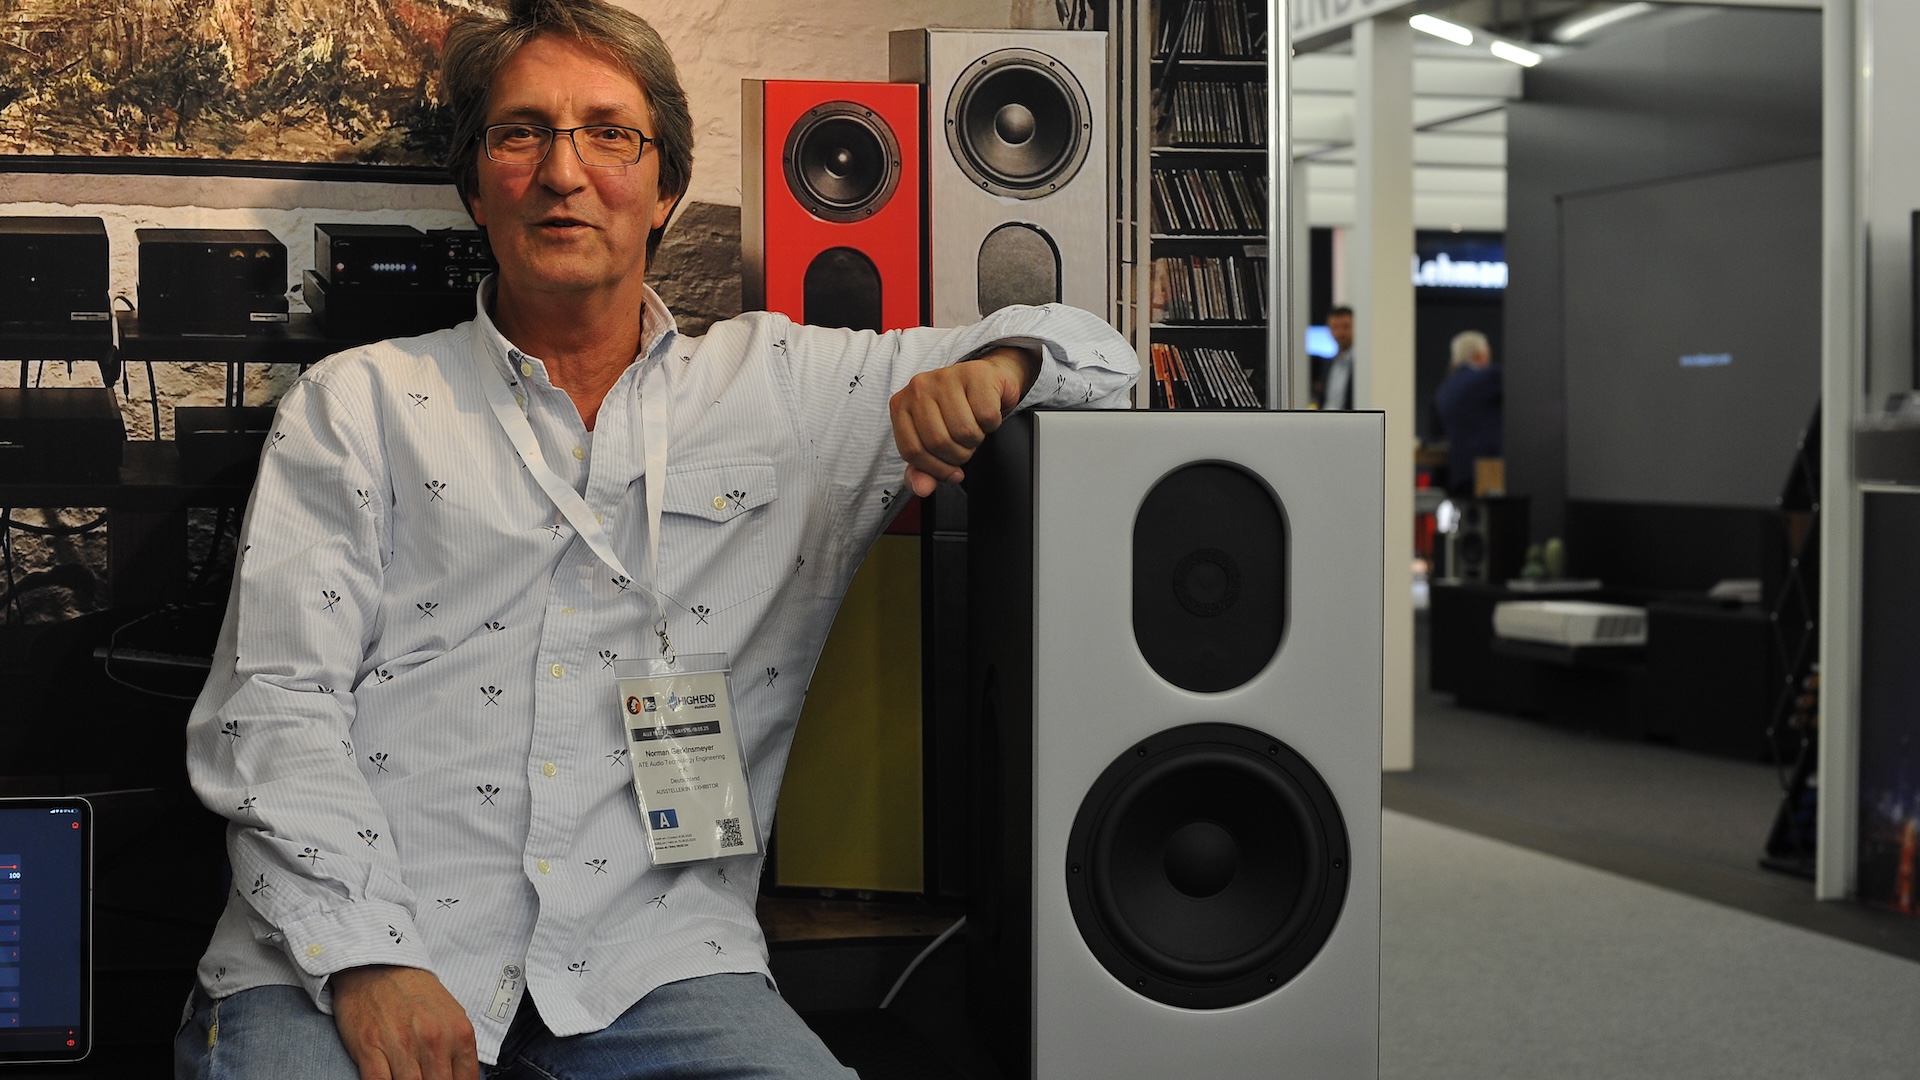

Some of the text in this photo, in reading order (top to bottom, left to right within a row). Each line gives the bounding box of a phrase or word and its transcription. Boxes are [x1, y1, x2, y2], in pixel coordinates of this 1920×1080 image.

[650, 759, 664, 767] Audio
[665, 757, 695, 766] Tecnolgy
[695, 754, 726, 764] Engineering
[670, 775, 700, 784] Deutschland
[660, 812, 671, 828] A
